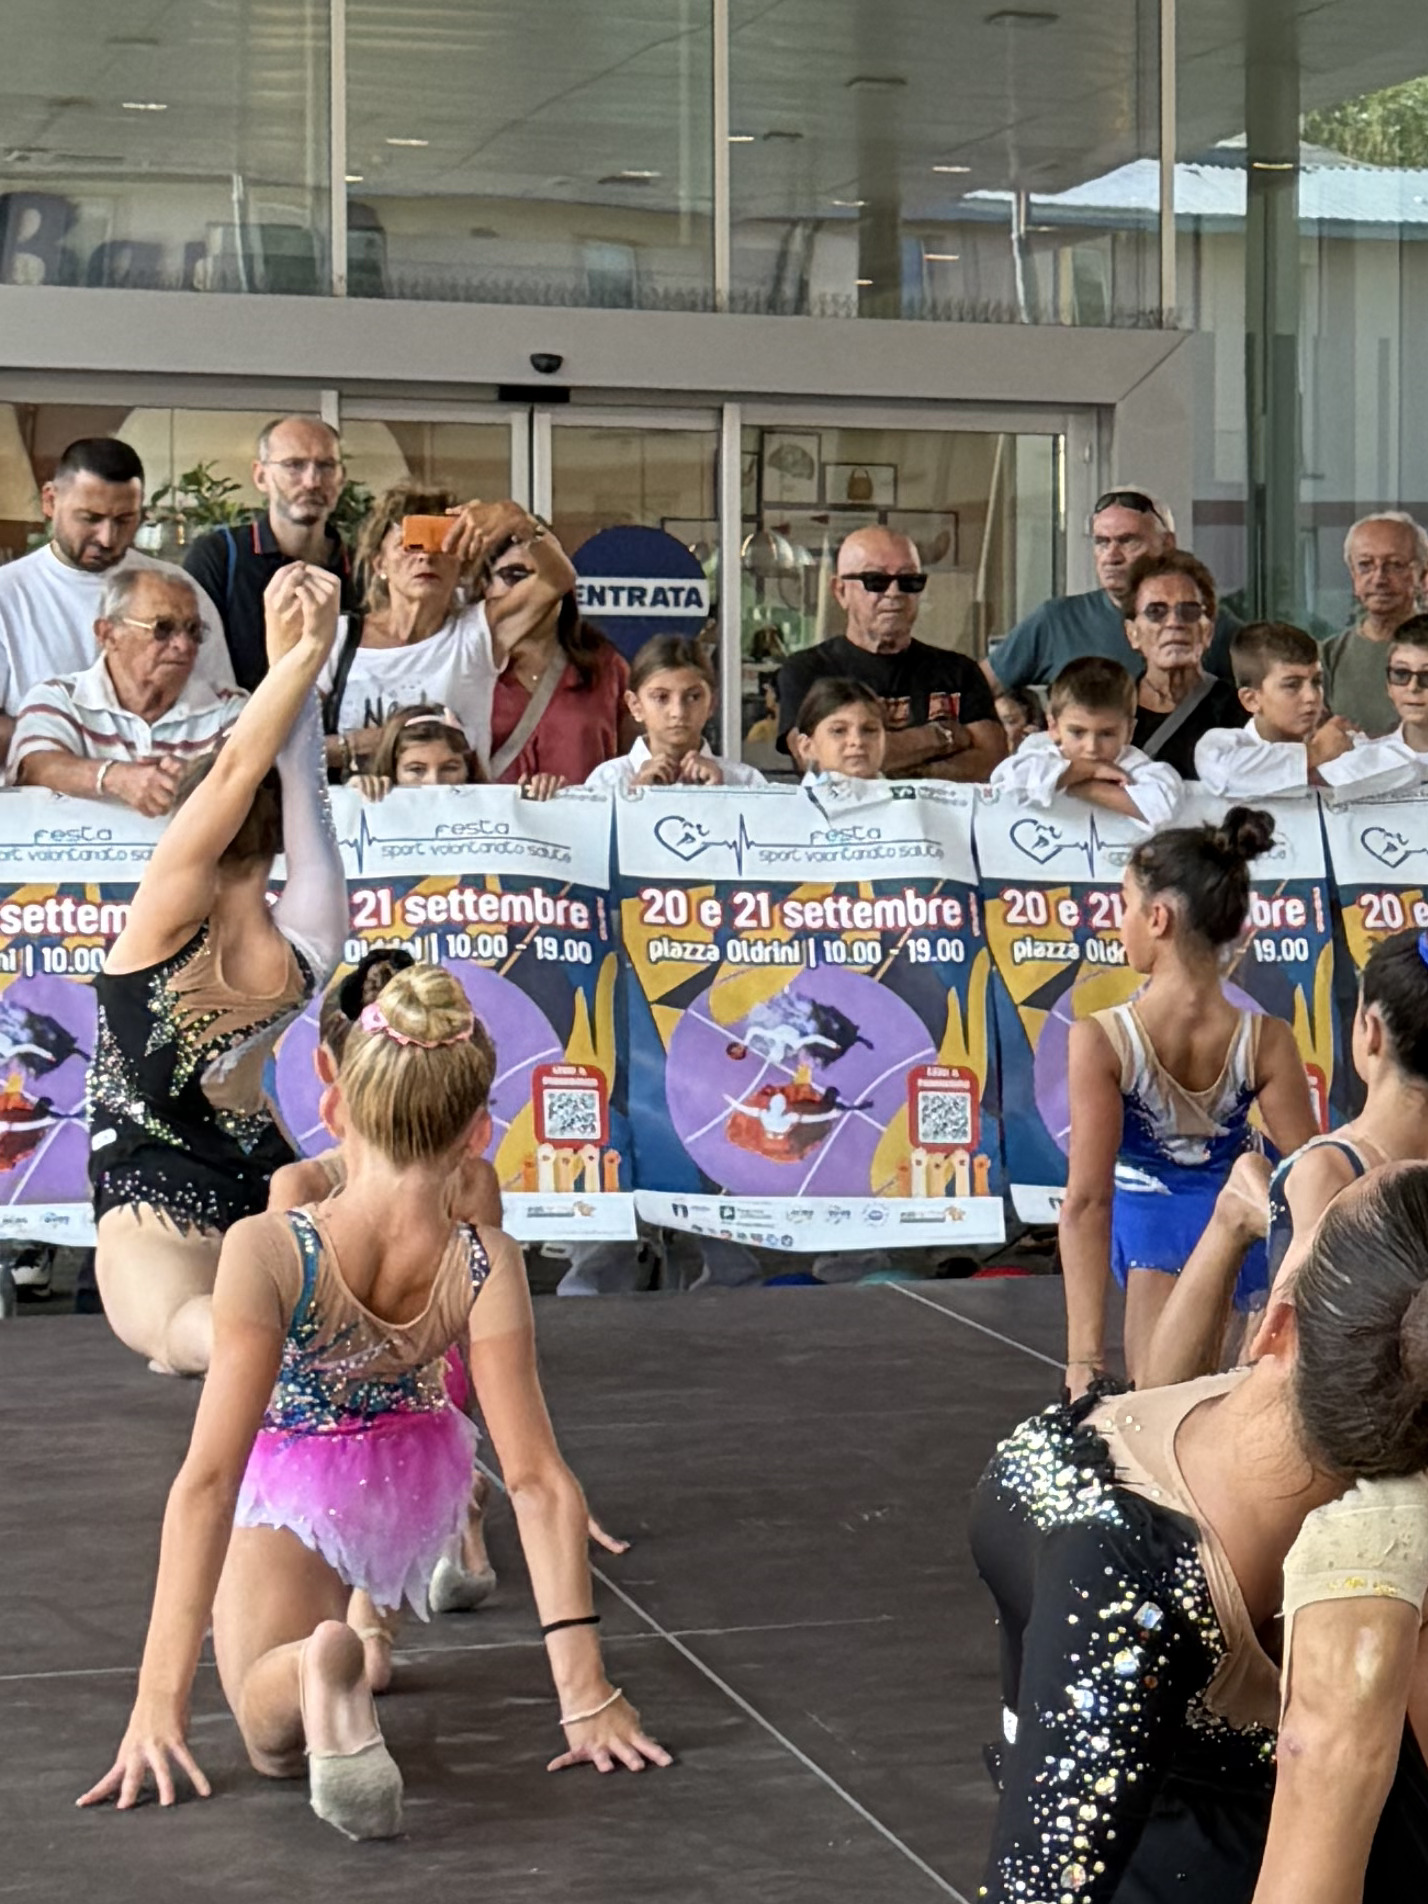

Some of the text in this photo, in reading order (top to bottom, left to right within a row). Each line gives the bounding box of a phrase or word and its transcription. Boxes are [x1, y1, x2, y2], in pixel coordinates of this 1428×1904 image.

[576, 584, 703, 608] ENTRATA
[0, 897, 132, 934] settem
[352, 887, 392, 928] 21
[403, 886, 590, 929] settembre
[641, 888, 688, 925] 20
[701, 902, 722, 927] e
[733, 891, 772, 928] 21
[782, 887, 964, 929] settembre
[1002, 888, 1048, 925] 20
[1059, 897, 1080, 927] e
[1089, 892, 1122, 928] 21
[1361, 892, 1404, 928] 20
[446, 934, 508, 958] 10.00
[534, 936, 593, 964] 19.00
[650, 938, 720, 964] piazza
[727, 939, 800, 964] Oldrini
[824, 940, 881, 964] 10.00
[906, 938, 966, 963] 19.00
[1013, 937, 1309, 964] piazza Oldr 19.00
